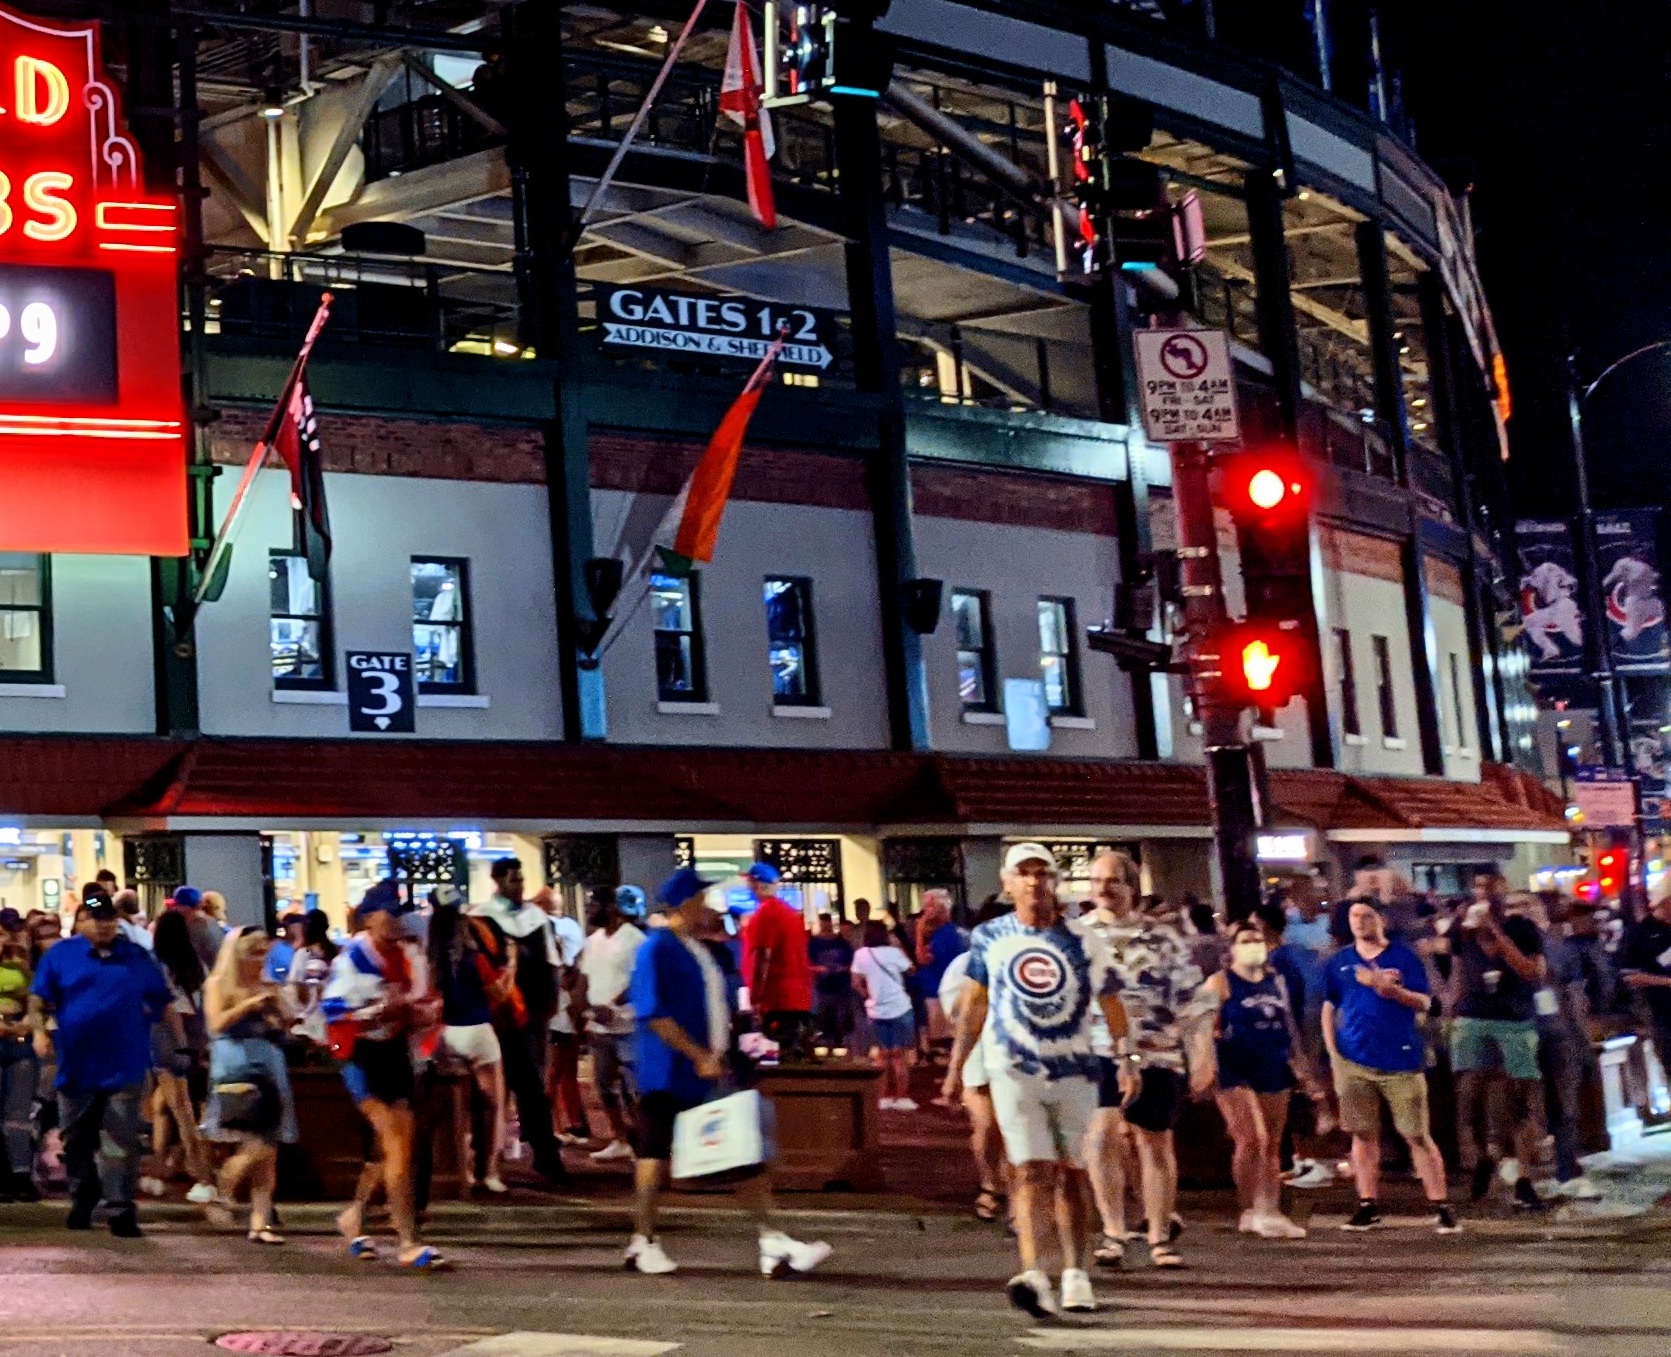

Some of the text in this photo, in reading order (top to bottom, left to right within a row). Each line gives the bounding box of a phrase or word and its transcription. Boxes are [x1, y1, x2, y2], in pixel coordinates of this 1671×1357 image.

[609, 289, 748, 332] GATES
[20, 302, 57, 364] 9
[612, 326, 701, 348] ADDISON
[707, 336, 721, 351] &
[350, 654, 408, 671] GATE
[360, 670, 403, 715] 3
